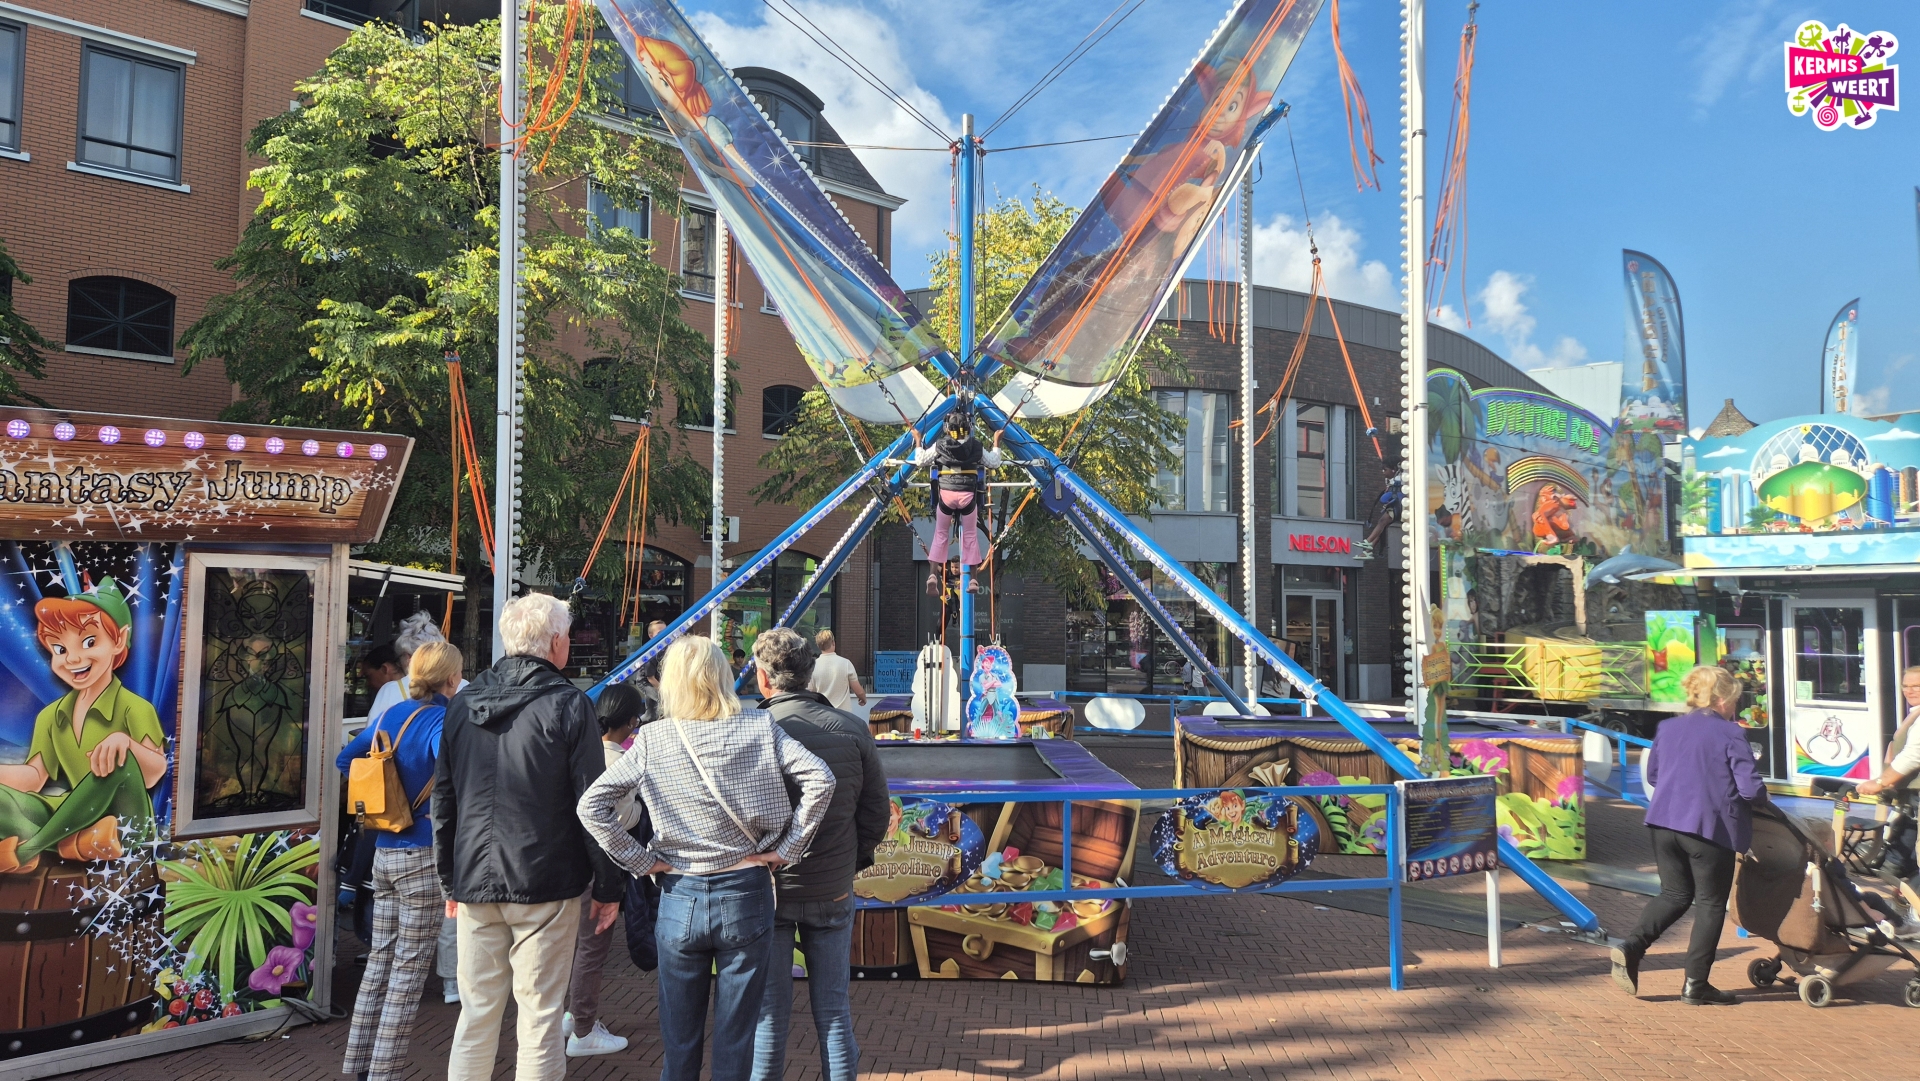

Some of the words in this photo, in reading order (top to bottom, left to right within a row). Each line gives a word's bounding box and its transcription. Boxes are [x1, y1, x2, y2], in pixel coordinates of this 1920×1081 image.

[0, 466, 191, 511] antasy
[208, 460, 353, 514] Jump
[1289, 534, 1351, 554] NELSON
[904, 836, 955, 860] Jump
[1193, 831, 1206, 849] A
[1209, 825, 1276, 847] Magical
[853, 858, 942, 880] rampoline
[1197, 849, 1277, 870] Adventure
